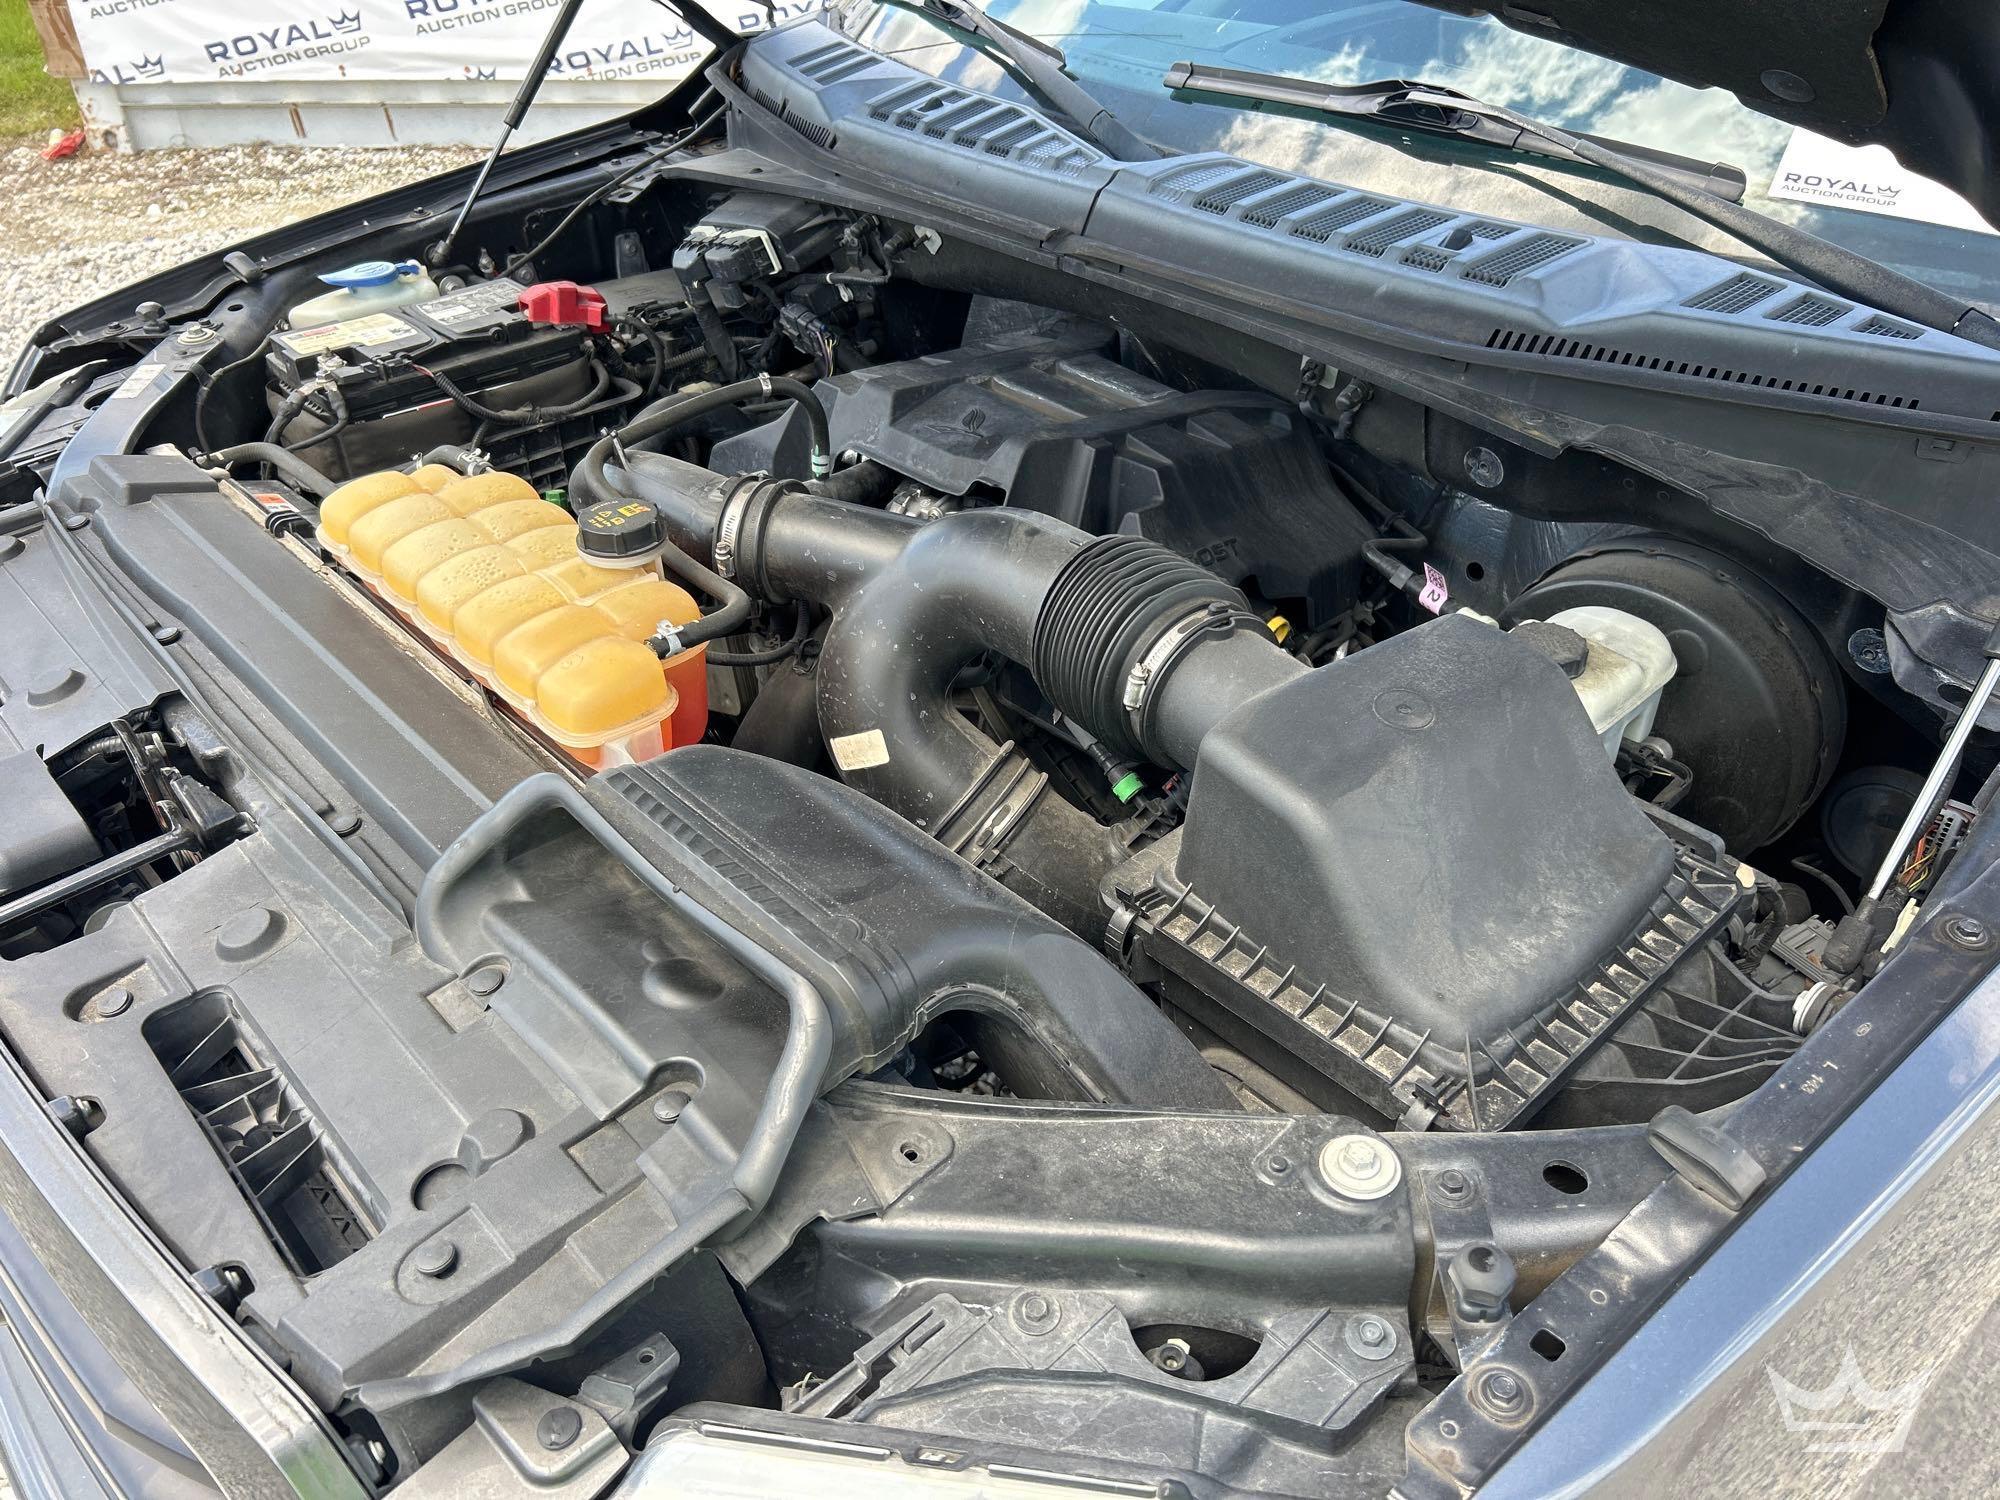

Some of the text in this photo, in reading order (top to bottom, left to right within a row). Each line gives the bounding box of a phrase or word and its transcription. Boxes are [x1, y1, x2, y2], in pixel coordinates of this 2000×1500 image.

[416, 7, 500, 36] AUCTION
[503, 0, 563, 15] GROU
[204, 20, 332, 63] ROYAL
[219, 36, 370, 78] AUCTION GROUP
[636, 52, 702, 75] GROUP
[1782, 184, 1896, 206] AUCTION GROUP
[1785, 172, 1873, 194] ROYAL
[1188, 538, 1238, 567] OST
